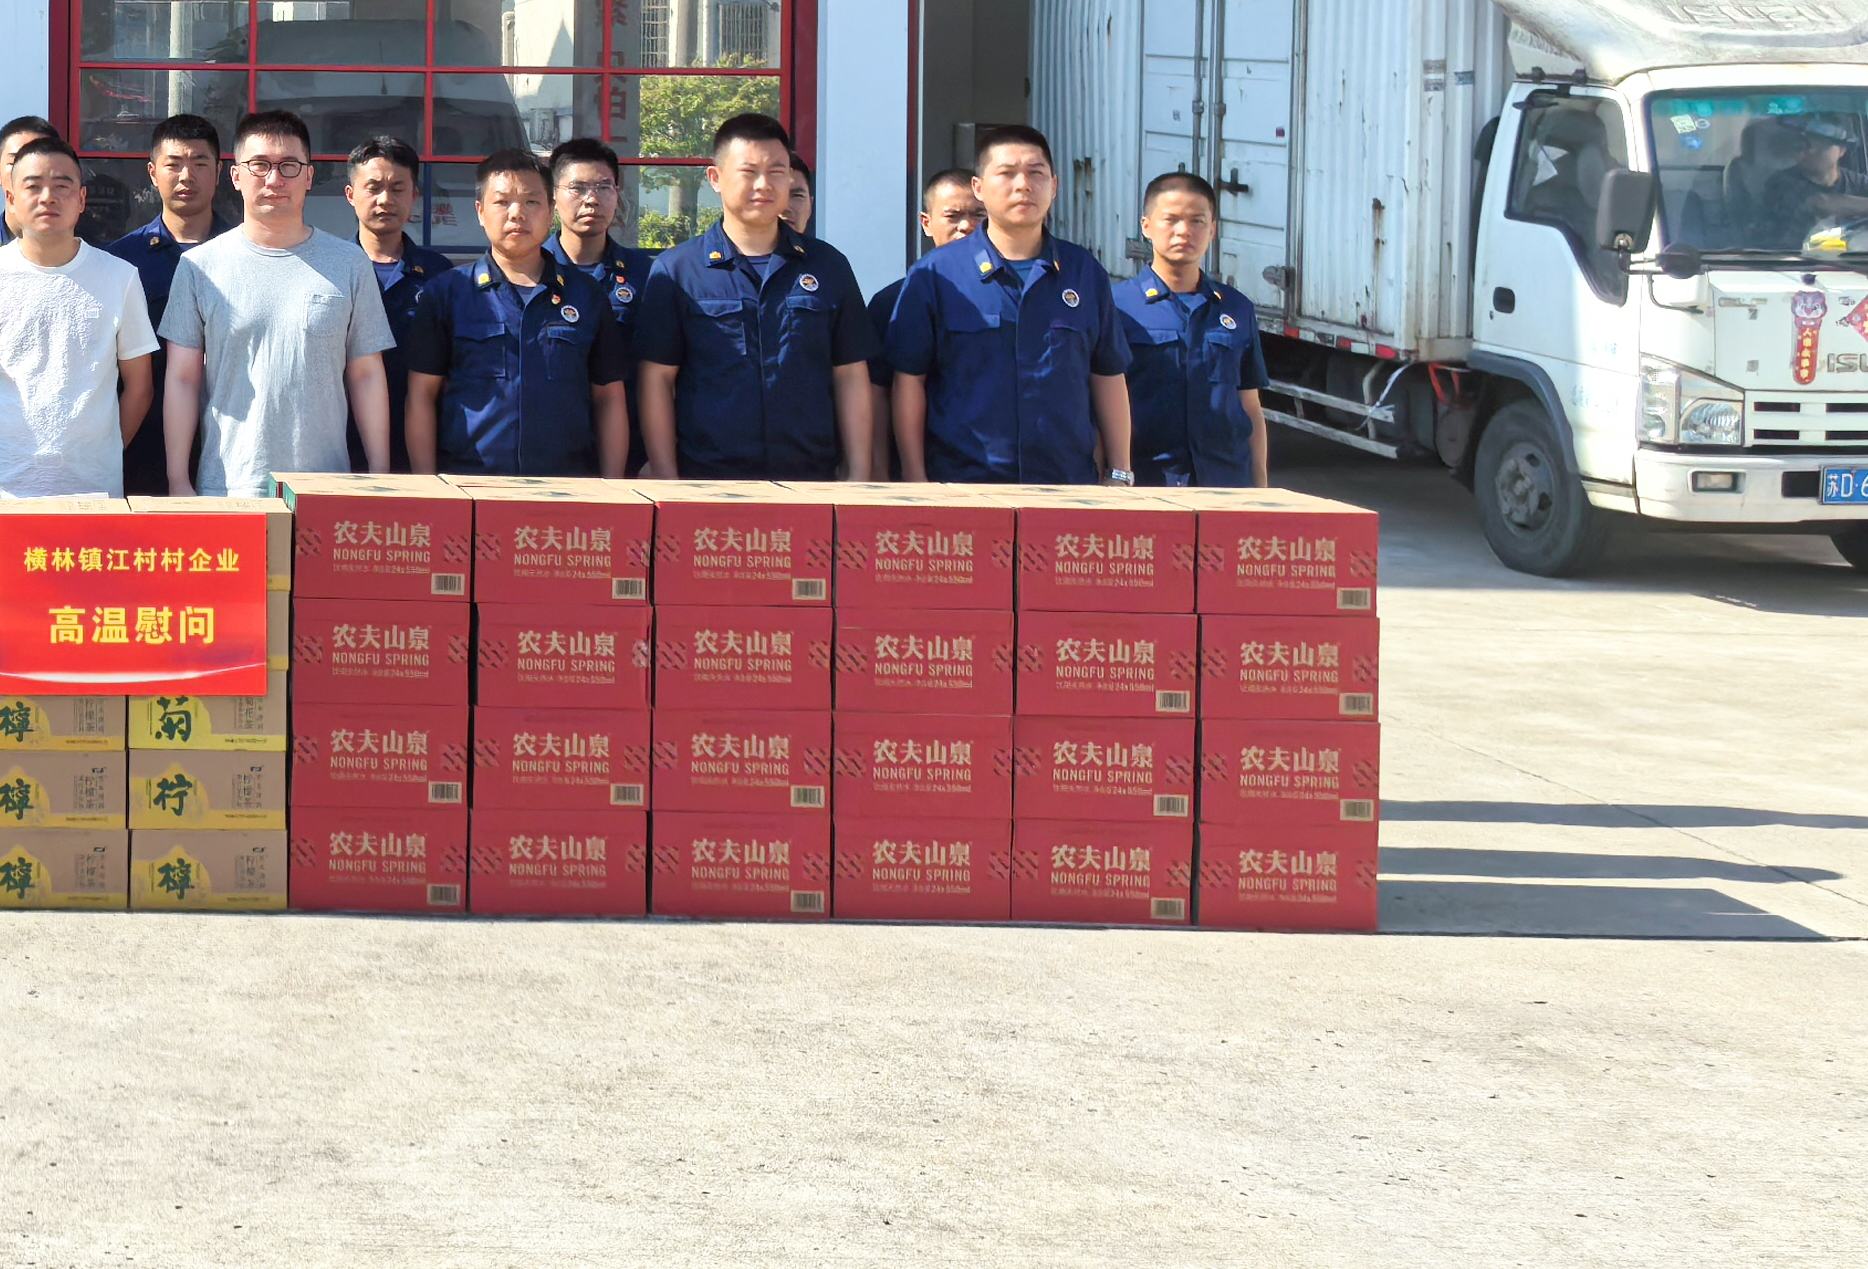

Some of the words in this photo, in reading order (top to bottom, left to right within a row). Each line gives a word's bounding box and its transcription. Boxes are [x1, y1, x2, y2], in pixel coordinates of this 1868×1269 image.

[334, 521, 431, 548] 农夫山泉
[514, 526, 612, 552] 农夫山泉
[694, 527, 792, 553] 农夫山泉
[875, 530, 974, 556] 农夫山泉
[1055, 533, 1154, 560] 农夫山泉
[24, 547, 240, 572] 横林镇江村村企业
[333, 548, 381, 561] NONGFU
[386, 551, 430, 563] SPRING
[514, 553, 562, 566] NONGFU
[567, 555, 611, 568] SPRING
[1237, 536, 1336, 562] 农夫山泉
[694, 555, 742, 568] NONGFU
[746, 555, 792, 569] SPRING
[875, 558, 924, 571] NONGFU
[928, 559, 973, 572] SPRING
[1055, 561, 1104, 574] NONGFU
[1109, 562, 1154, 575] SPRING
[1237, 564, 1286, 577] NONGFU
[1291, 565, 1336, 578] SPRING
[49, 606, 214, 644] 高温慰问
[332, 624, 430, 651] 农夫山泉
[517, 630, 615, 657] 农夫山泉
[694, 629, 792, 656] 农夫山泉
[875, 635, 973, 661] 农夫山泉
[1056, 638, 1155, 664] 农夫山泉
[1240, 641, 1339, 667] 农夫山泉
[332, 652, 380, 665] NONGFU
[385, 653, 429, 667] SPRING
[517, 658, 566, 671] NONGFU
[570, 659, 615, 673] SPRING
[694, 658, 742, 670] NONGFU
[747, 659, 792, 672] SPRING
[875, 663, 923, 676] NONGFU
[928, 664, 973, 677] SPRING
[1056, 665, 1104, 678] NONGFU
[1109, 667, 1154, 680] SPRING
[1240, 669, 1288, 681] NONGFU
[1294, 670, 1339, 683] SPRING
[330, 729, 428, 756] 农夫山泉
[513, 732, 610, 757] 农夫山泉
[691, 733, 790, 760] 农夫山泉
[873, 739, 972, 765] 农夫山泉
[1053, 741, 1153, 768] 农夫山泉
[330, 757, 378, 769] NONGFU
[383, 759, 428, 771] SPRING
[512, 759, 560, 772] NONGFU
[565, 761, 610, 774] SPRING
[691, 761, 740, 774] NONGFU
[744, 762, 789, 775] SPRING
[1240, 746, 1340, 773] 农夫山泉
[873, 767, 922, 780] NONGFU
[927, 768, 971, 781] SPRING
[1053, 769, 1102, 782] NONGFU
[1107, 770, 1153, 783] SPRING
[1240, 774, 1289, 787] NONGFU
[1294, 775, 1339, 789] SPRING
[329, 831, 427, 858] 农夫山泉
[509, 835, 607, 861] 农夫山泉
[691, 838, 790, 865] 农夫山泉
[873, 839, 970, 865] 农夫山泉
[329, 859, 376, 872] NONGFU
[381, 860, 426, 874] SPRING
[509, 863, 557, 876] NONGFU
[562, 864, 606, 877] SPRING
[1051, 844, 1150, 871] 农夫山泉
[1239, 849, 1337, 875] 农夫山泉
[691, 866, 740, 879] NONGFU
[744, 868, 789, 881] SPRING
[872, 868, 920, 880] NONGFU
[925, 869, 970, 882] SPRING
[1051, 872, 1100, 885] NONGFU
[1105, 874, 1150, 887] SPRING
[1238, 877, 1287, 891] NONGFU
[1292, 879, 1337, 892] SPRING
